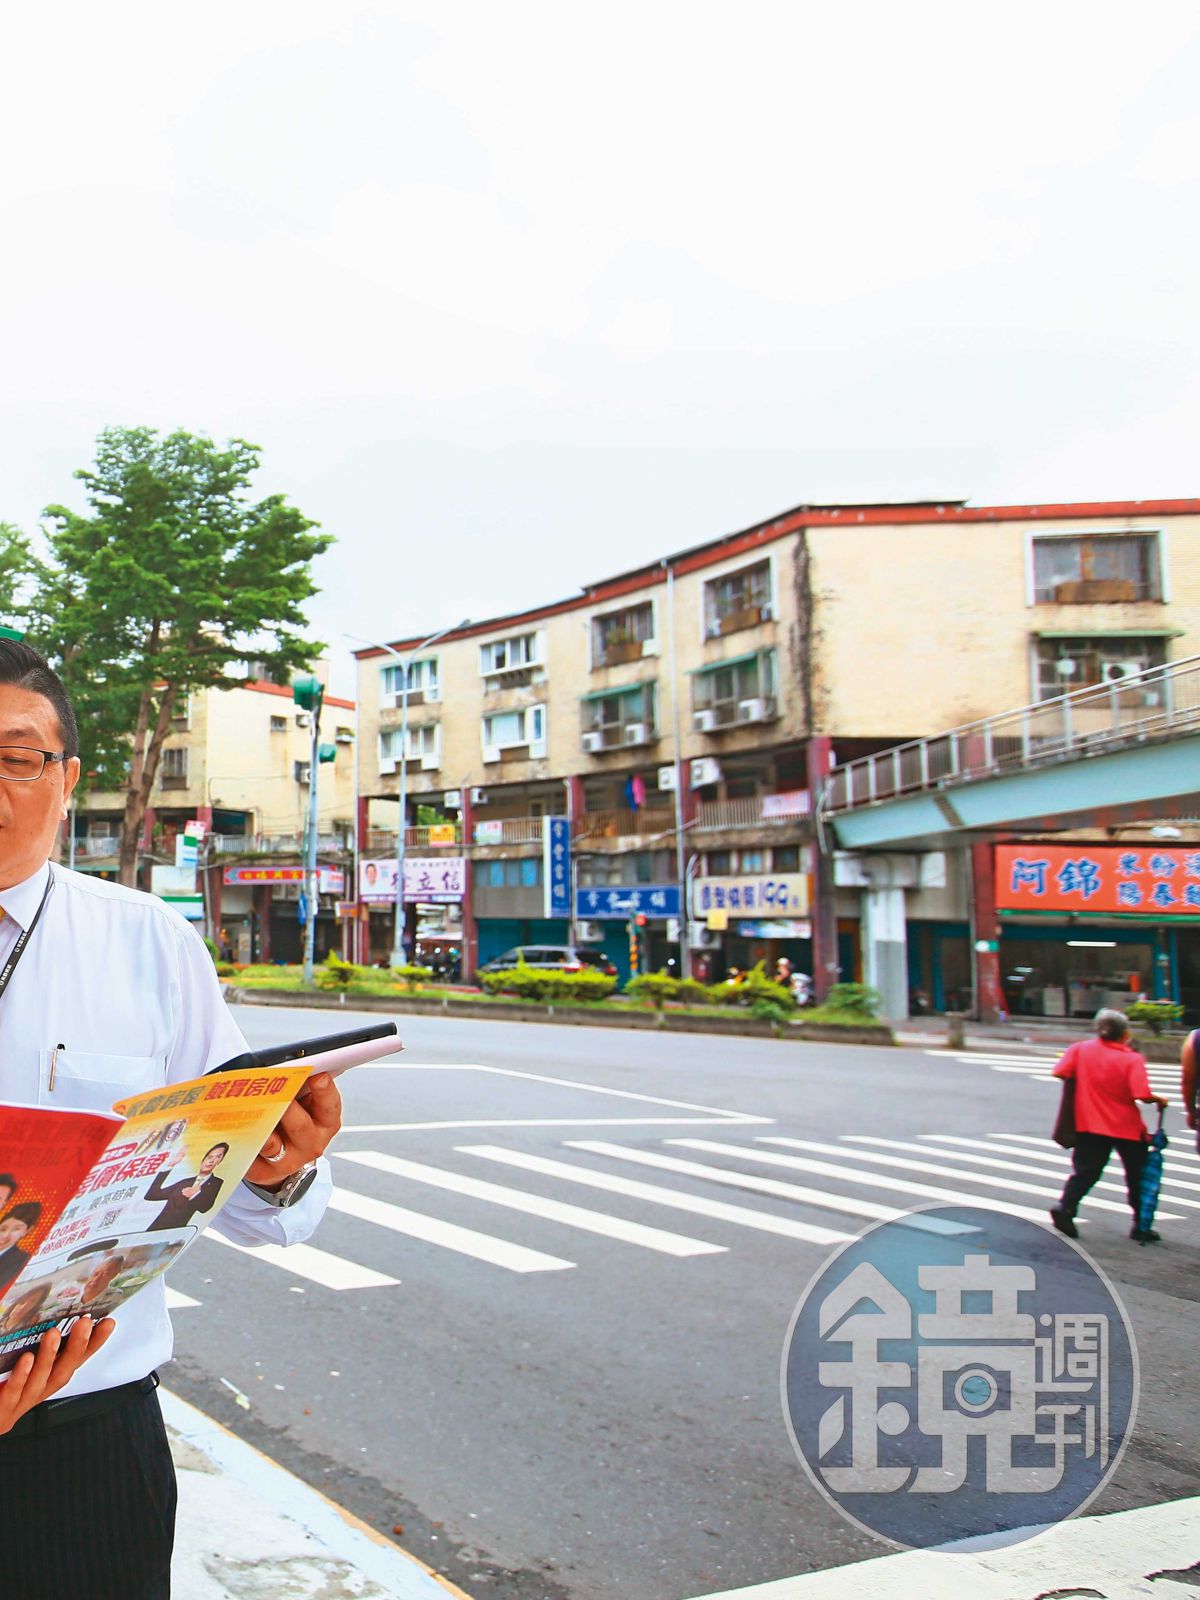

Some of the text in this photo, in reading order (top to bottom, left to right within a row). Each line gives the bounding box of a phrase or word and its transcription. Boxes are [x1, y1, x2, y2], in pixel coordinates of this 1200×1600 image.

[1012, 858, 1102, 901] 阿錦
[204, 1076, 289, 1101] 誠實房仲
